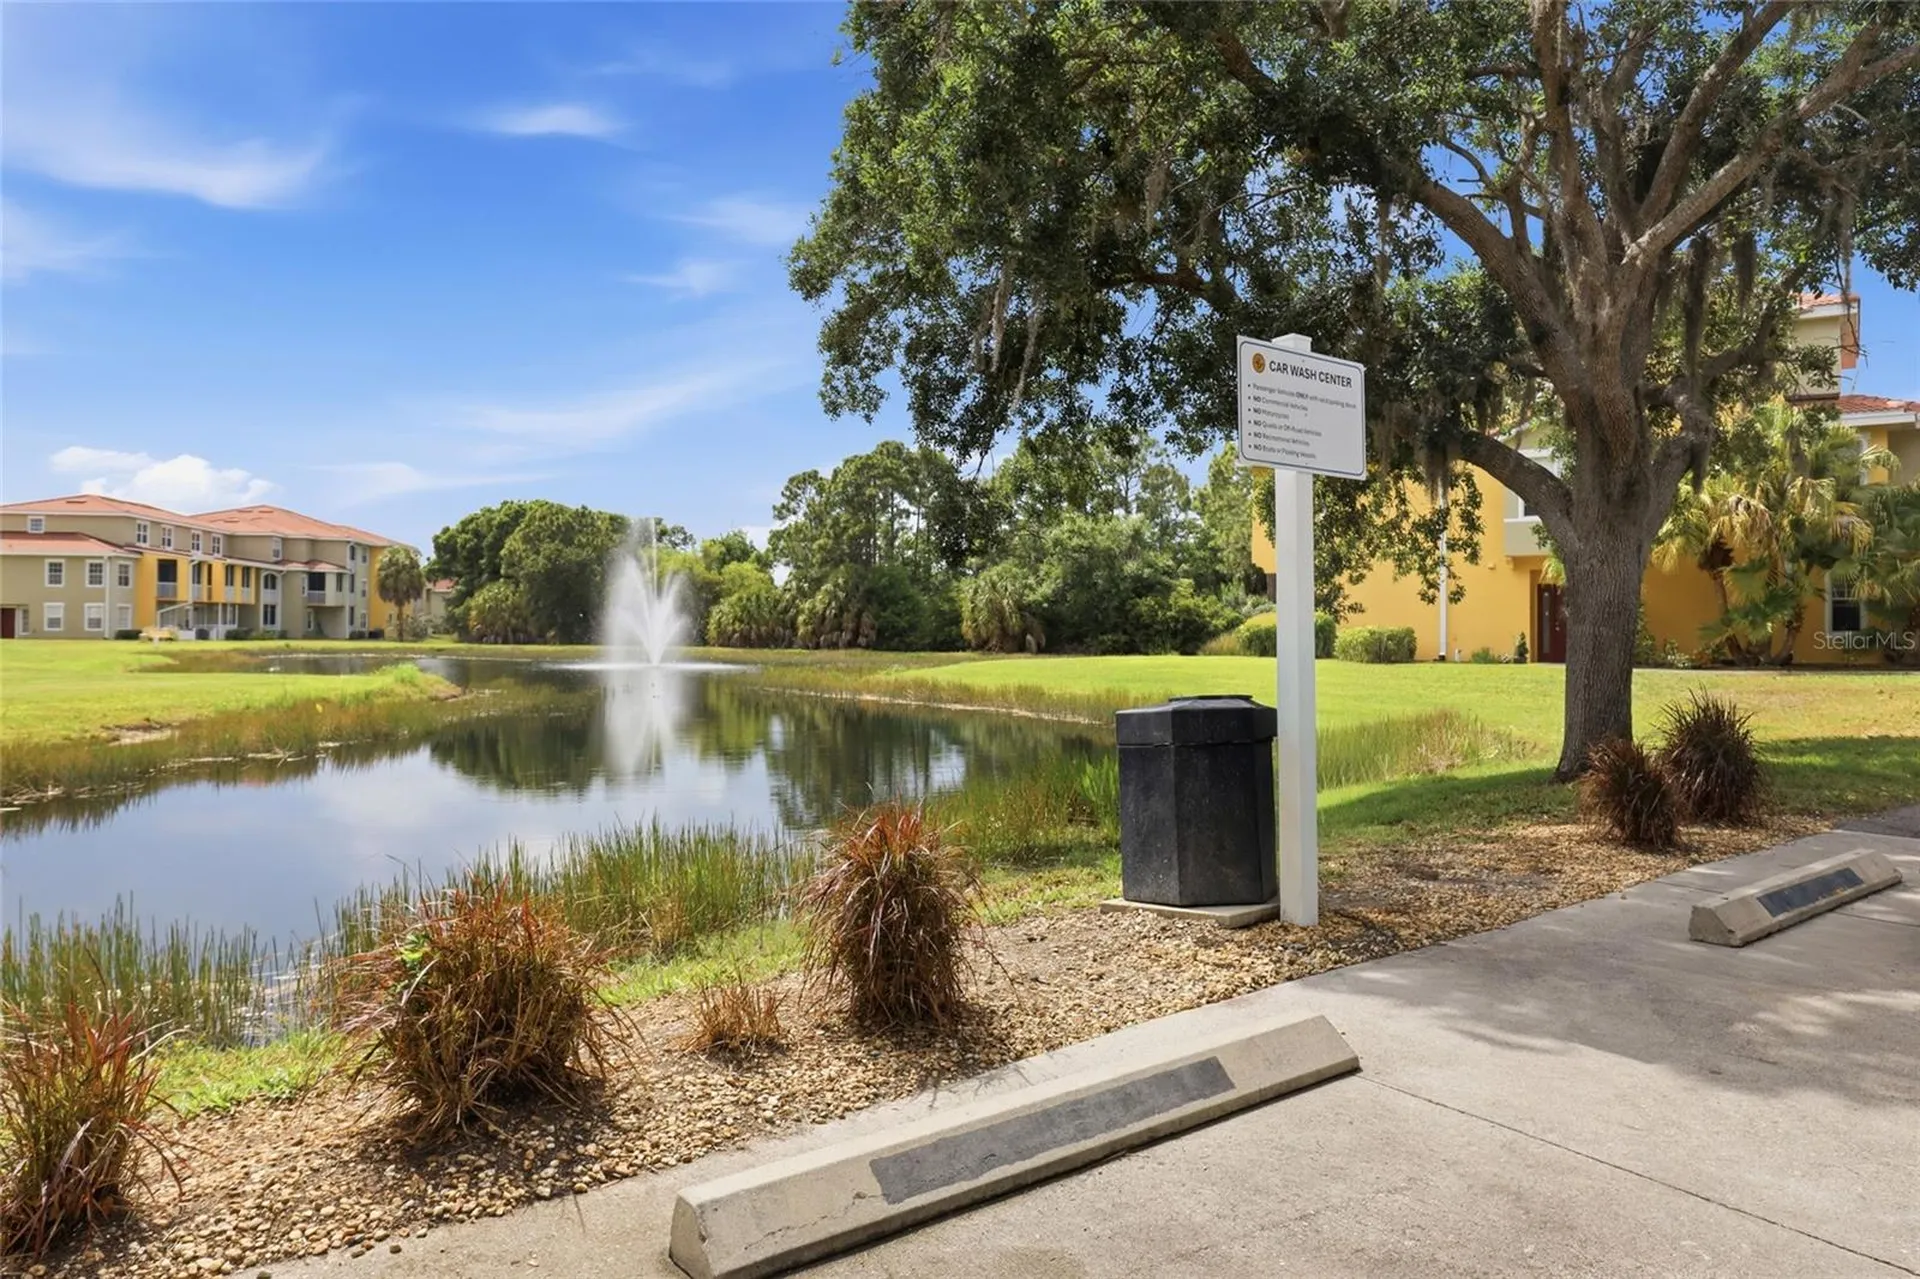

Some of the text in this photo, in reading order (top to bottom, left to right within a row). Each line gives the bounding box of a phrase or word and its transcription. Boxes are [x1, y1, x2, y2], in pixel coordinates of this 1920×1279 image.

[1269, 359, 1351, 388] CAR WASH CENTER
